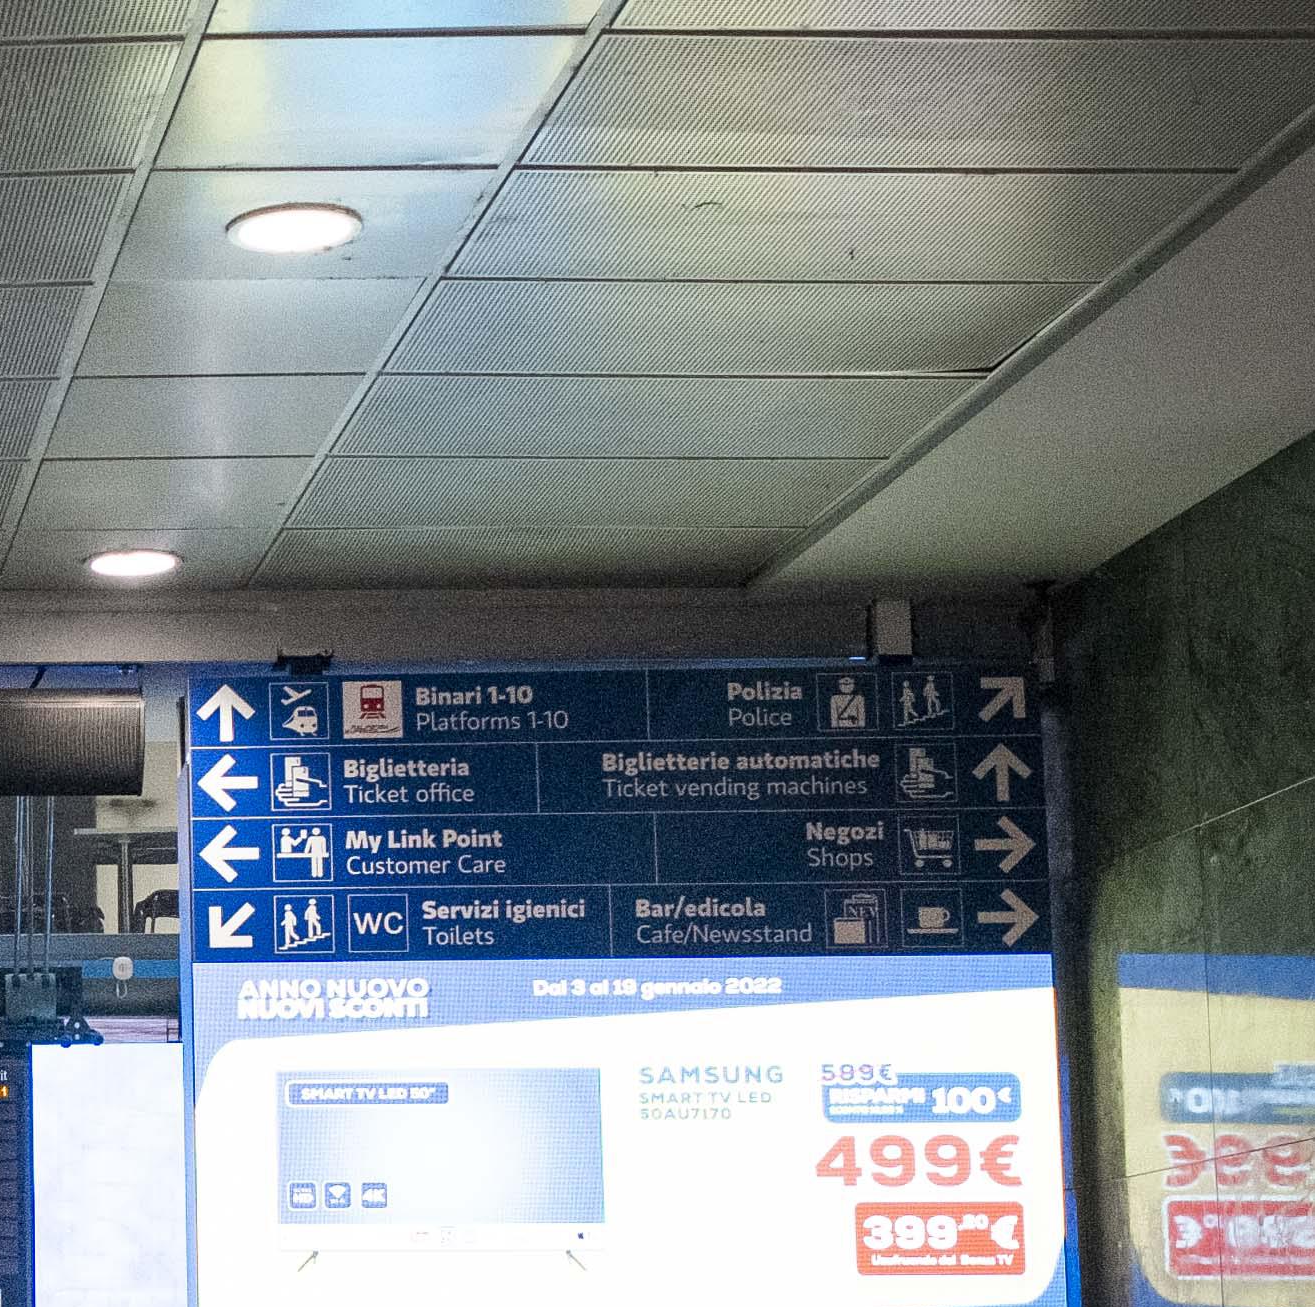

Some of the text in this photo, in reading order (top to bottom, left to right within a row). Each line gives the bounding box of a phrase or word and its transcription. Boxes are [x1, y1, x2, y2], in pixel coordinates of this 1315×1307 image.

[416, 686, 532, 705] Binari 1-10
[727, 681, 802, 700] Polizia
[416, 711, 568, 731] Platforms 1-10
[728, 708, 792, 726] Police
[344, 759, 469, 781] Biglietteria
[602, 750, 880, 776] Biglietterie automatiche
[344, 784, 475, 803] Ticket office
[603, 777, 867, 800] Ticket vending machines
[345, 829, 503, 853] My Link Point
[806, 821, 883, 845] Negozi
[346, 855, 506, 875] Customer Care
[807, 849, 874, 872] Shops
[422, 899, 585, 922] Servizi igienici
[635, 896, 766, 917] Bar/edicola
[353, 912, 404, 935] WC
[636, 923, 812, 944] Cafe/Newsstand
[423, 926, 495, 946] Toilets
[237, 976, 430, 1001] ANNO NUOVO
[532, 977, 783, 1000] Dal 3 al gennaio 2022
[237, 998, 430, 1021] NUOVI SCONTI
[638, 1065, 784, 1085] SAMSUNG
[300, 1086, 408, 1102] SMART TV LED
[638, 1091, 773, 1105] SMART TV LED
[931, 1087, 1013, 1115] 100€
[815, 1134, 1023, 1187] 499€
